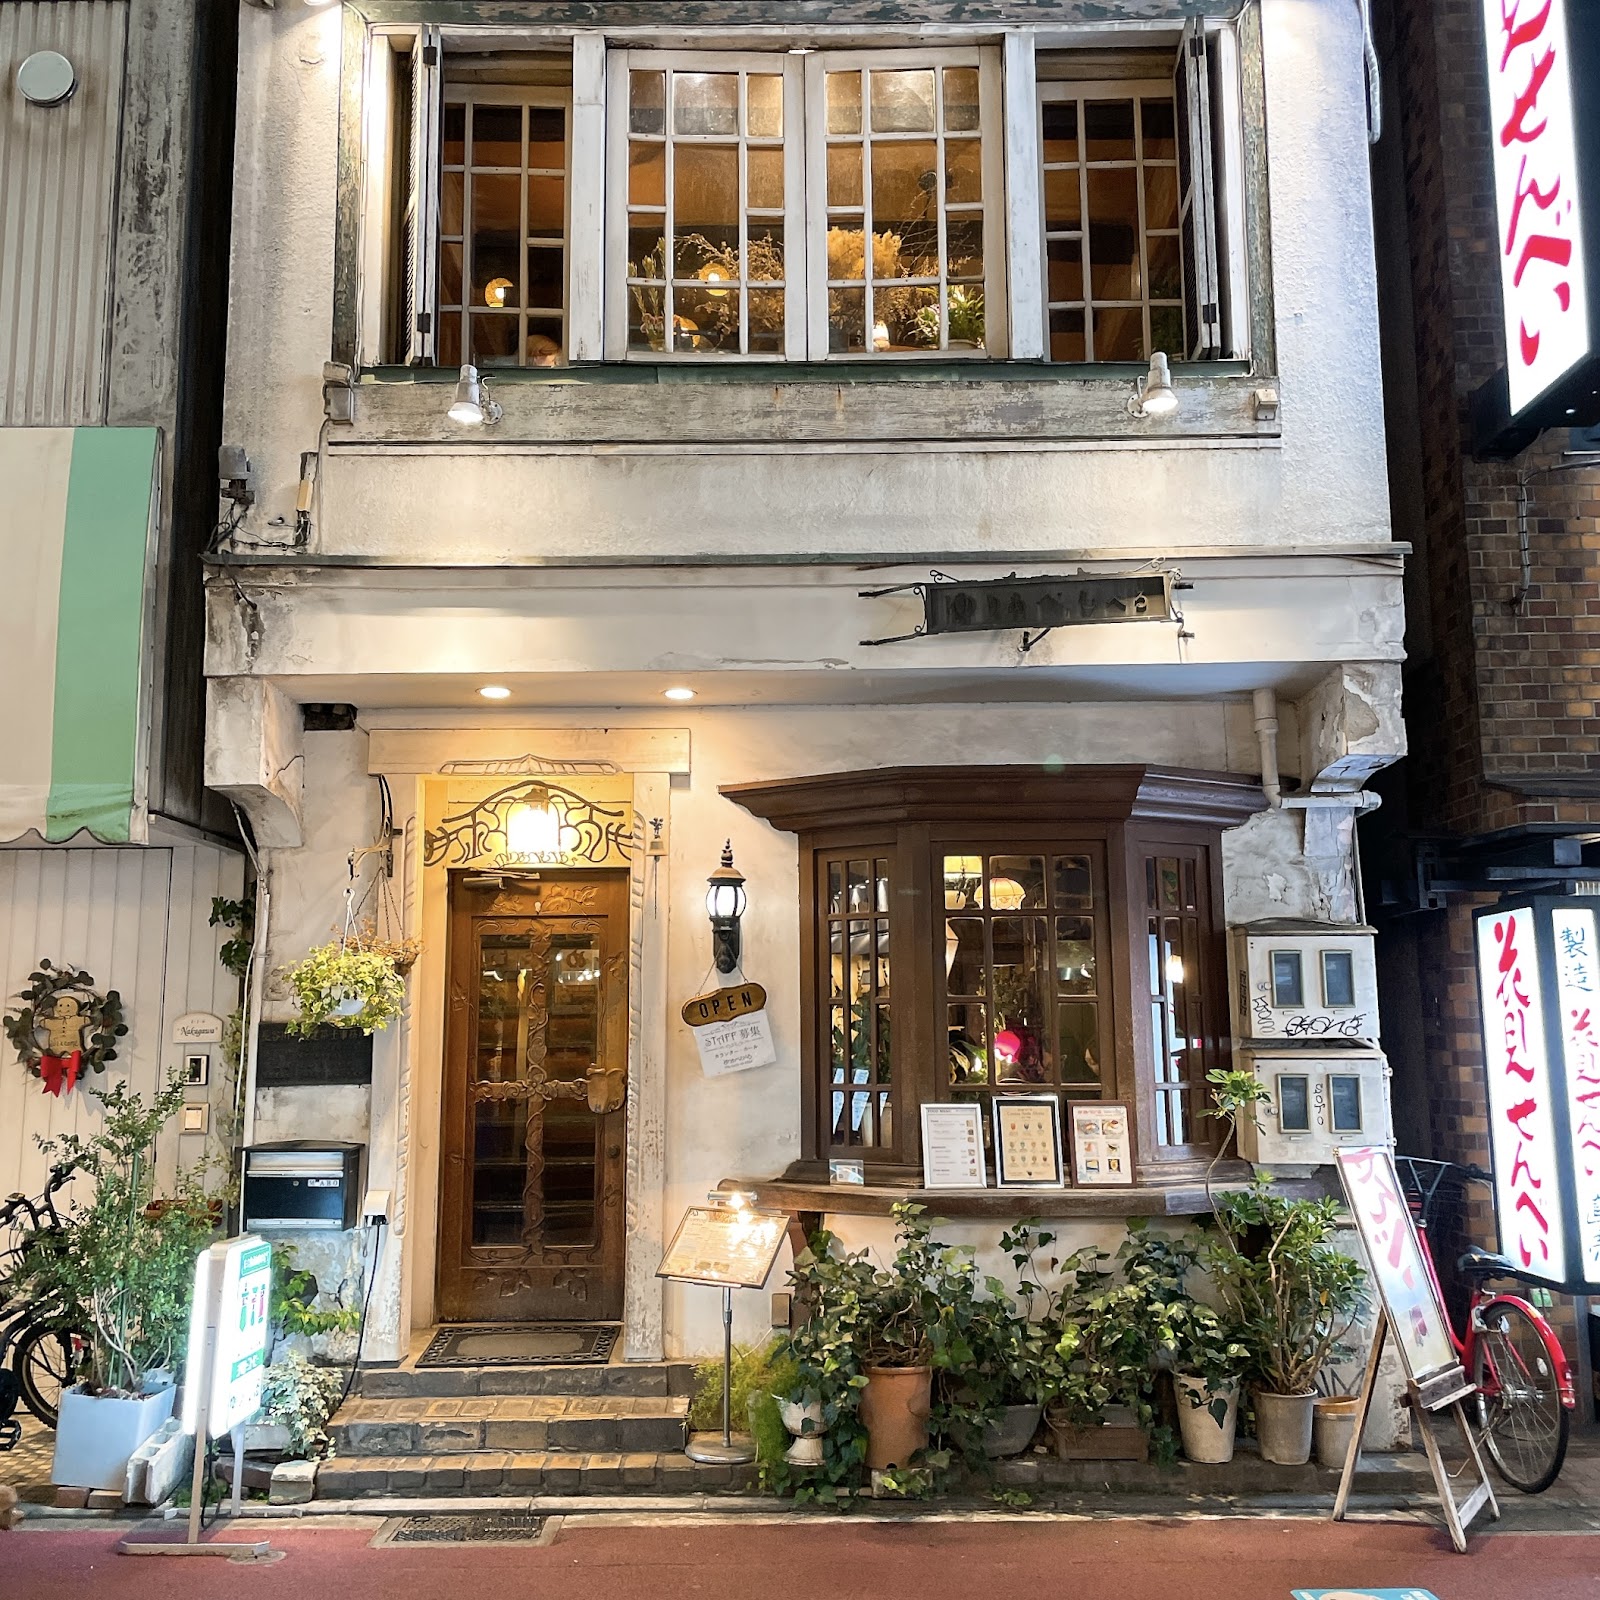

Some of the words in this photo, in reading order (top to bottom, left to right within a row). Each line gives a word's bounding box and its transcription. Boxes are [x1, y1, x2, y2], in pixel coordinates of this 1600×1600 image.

[698, 991, 752, 1018] OPEN
[181, 1025, 215, 1037] Nakagawa
[704, 1031, 737, 1047] STAFF
